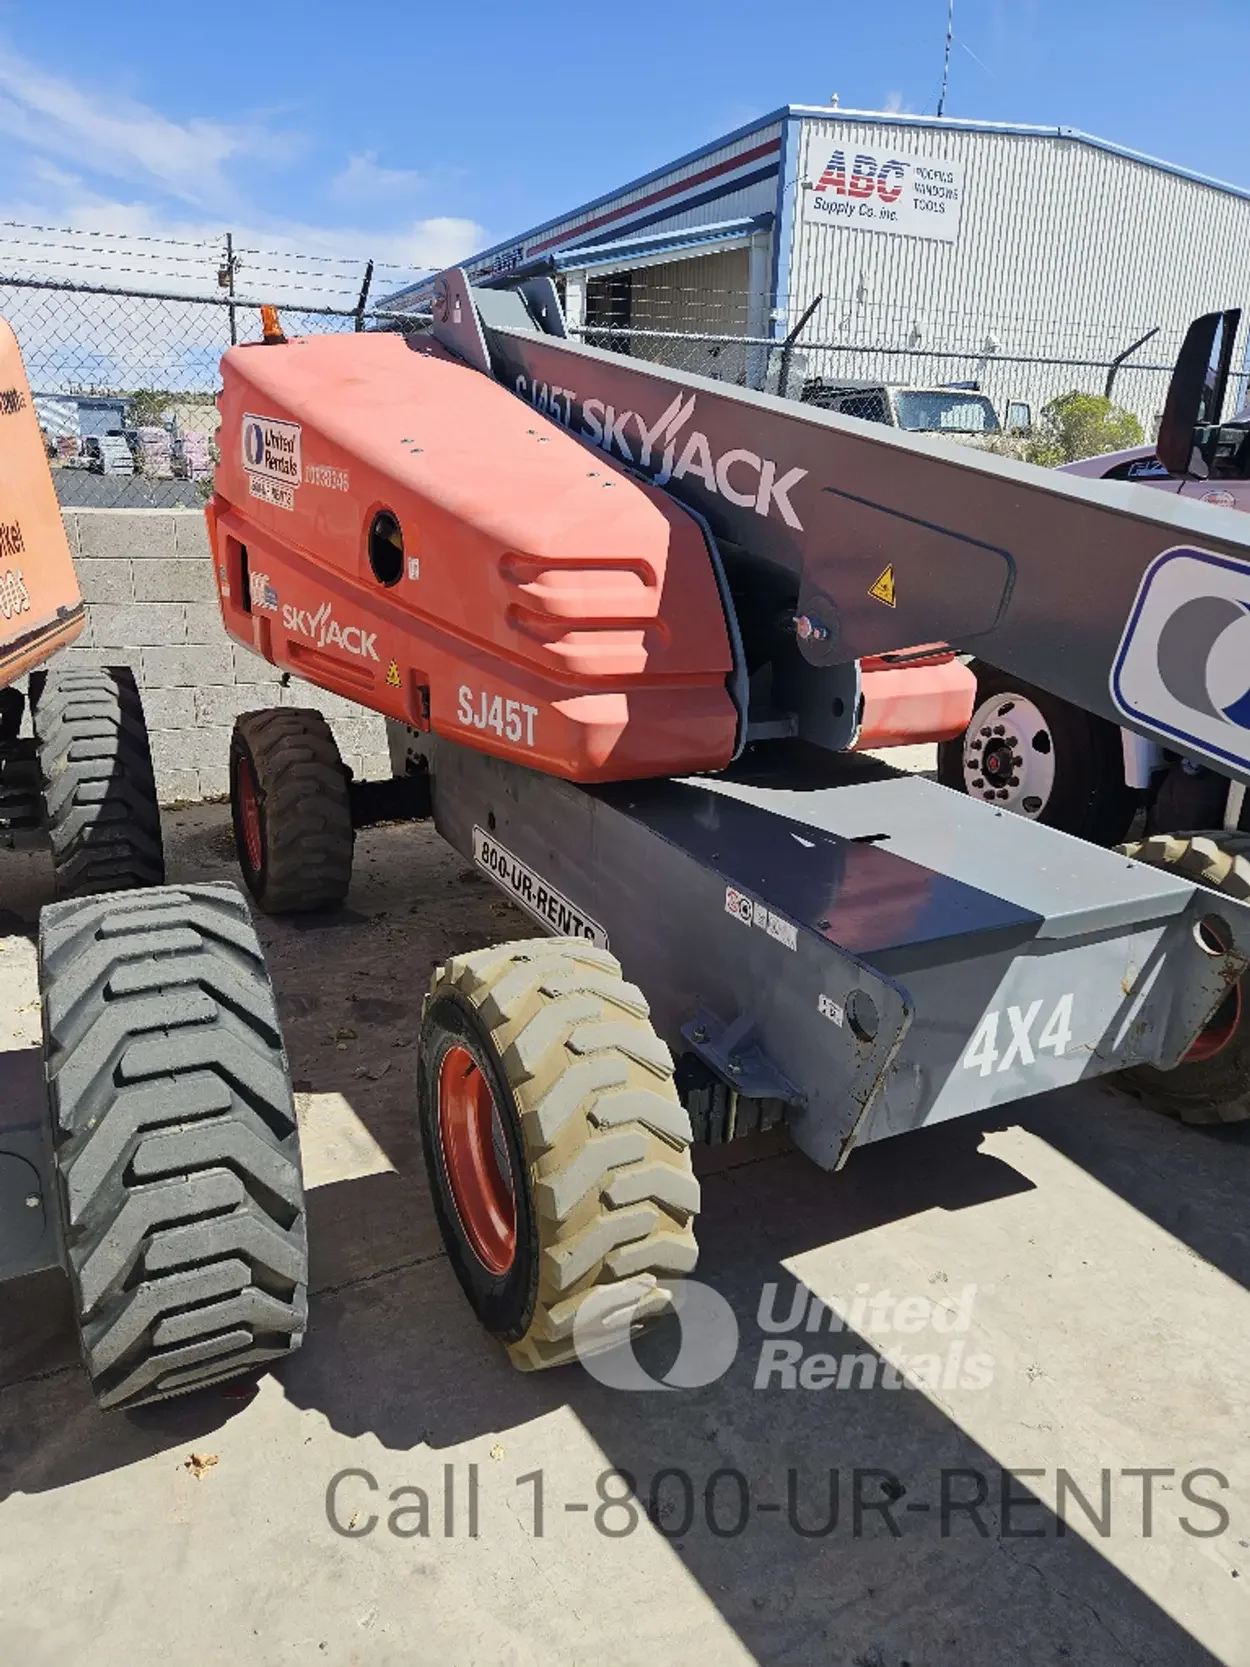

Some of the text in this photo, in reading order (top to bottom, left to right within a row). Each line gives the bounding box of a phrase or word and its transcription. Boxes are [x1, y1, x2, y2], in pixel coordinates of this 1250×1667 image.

[813, 150, 910, 203] ABC
[913, 167, 953, 184] ROOFING
[913, 182, 959, 200] WINDOWS
[813, 197, 856, 217] Supply
[859, 203, 877, 218] Co.
[913, 198, 945, 214] TOOLS
[265, 429, 296, 453] United
[265, 449, 297, 476] Rentals
[580, 390, 809, 532] SKYJACK
[282, 602, 380, 662] SKYJACK
[457, 685, 538, 747] SJ45T
[963, 992, 1074, 1077] 4X4
